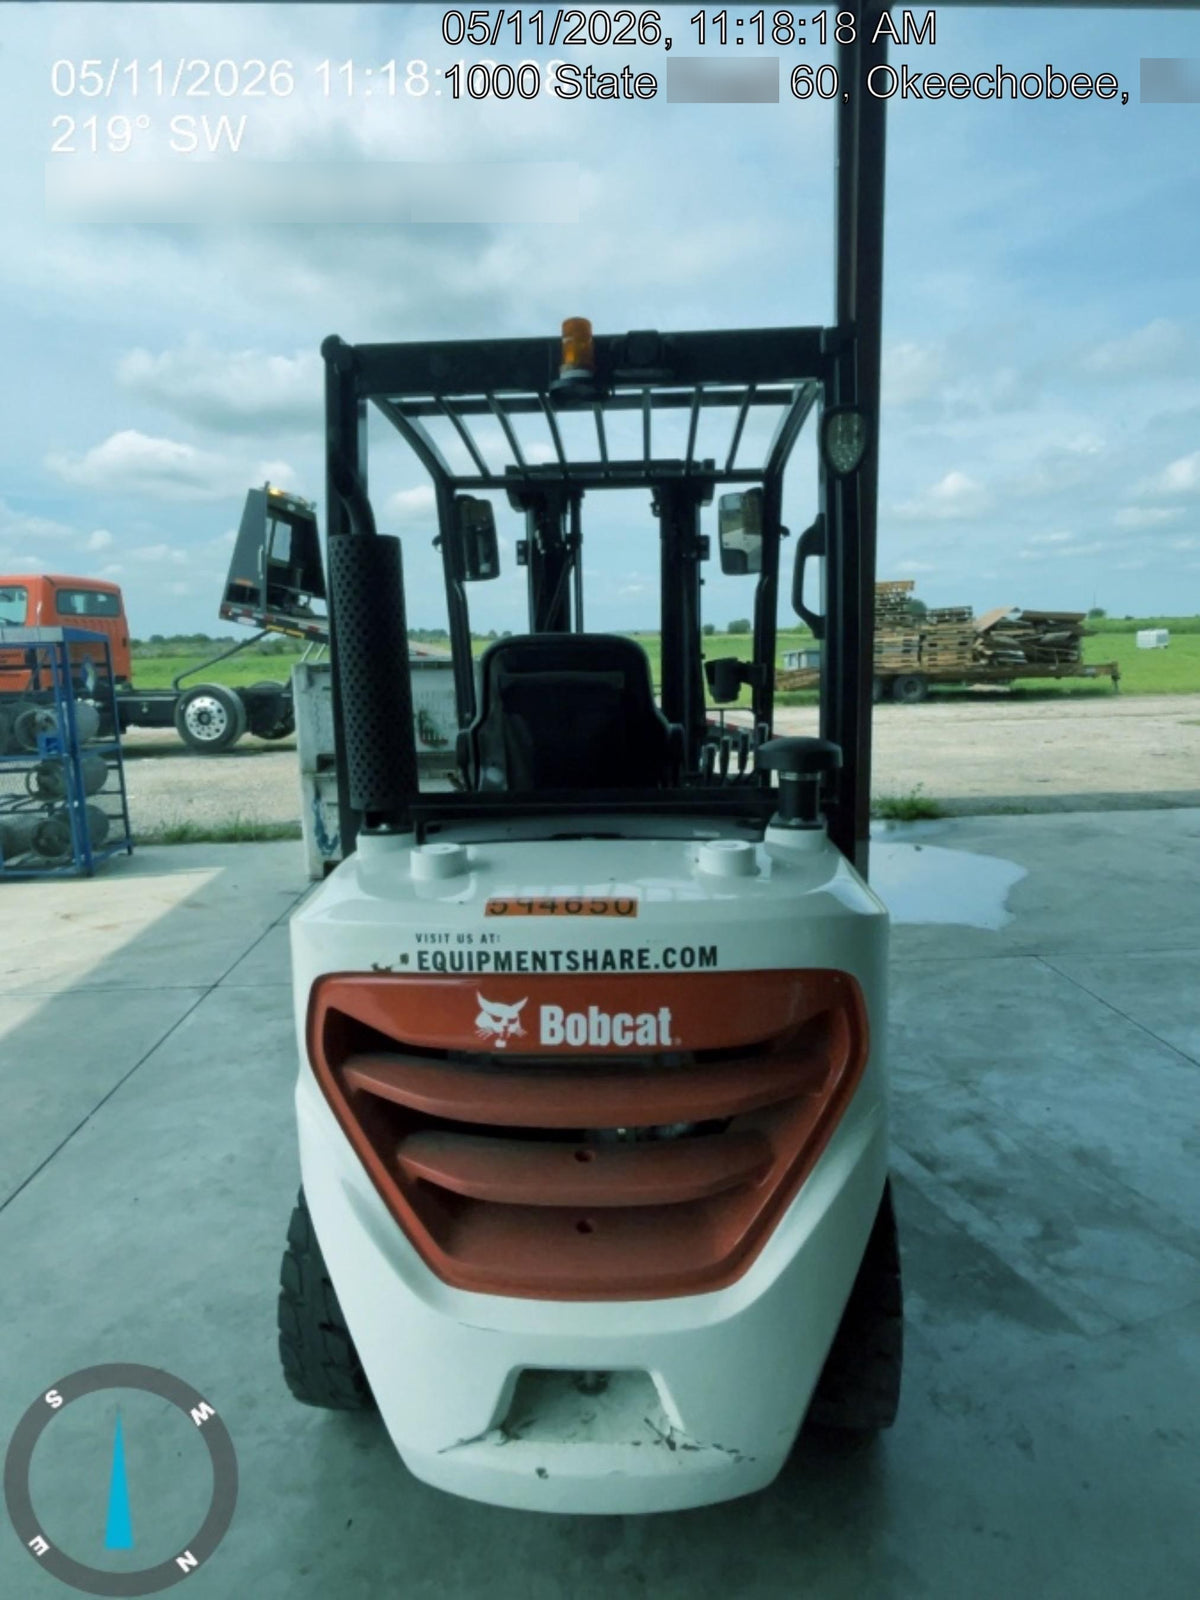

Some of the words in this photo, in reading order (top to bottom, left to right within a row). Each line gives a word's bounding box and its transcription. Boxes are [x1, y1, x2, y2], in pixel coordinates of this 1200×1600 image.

[415, 932, 450, 945] VISIT
[456, 932, 474, 945] US
[417, 945, 718, 973] EQUIPMENTSHARE.COM
[540, 1004, 672, 1047] Bobcat
